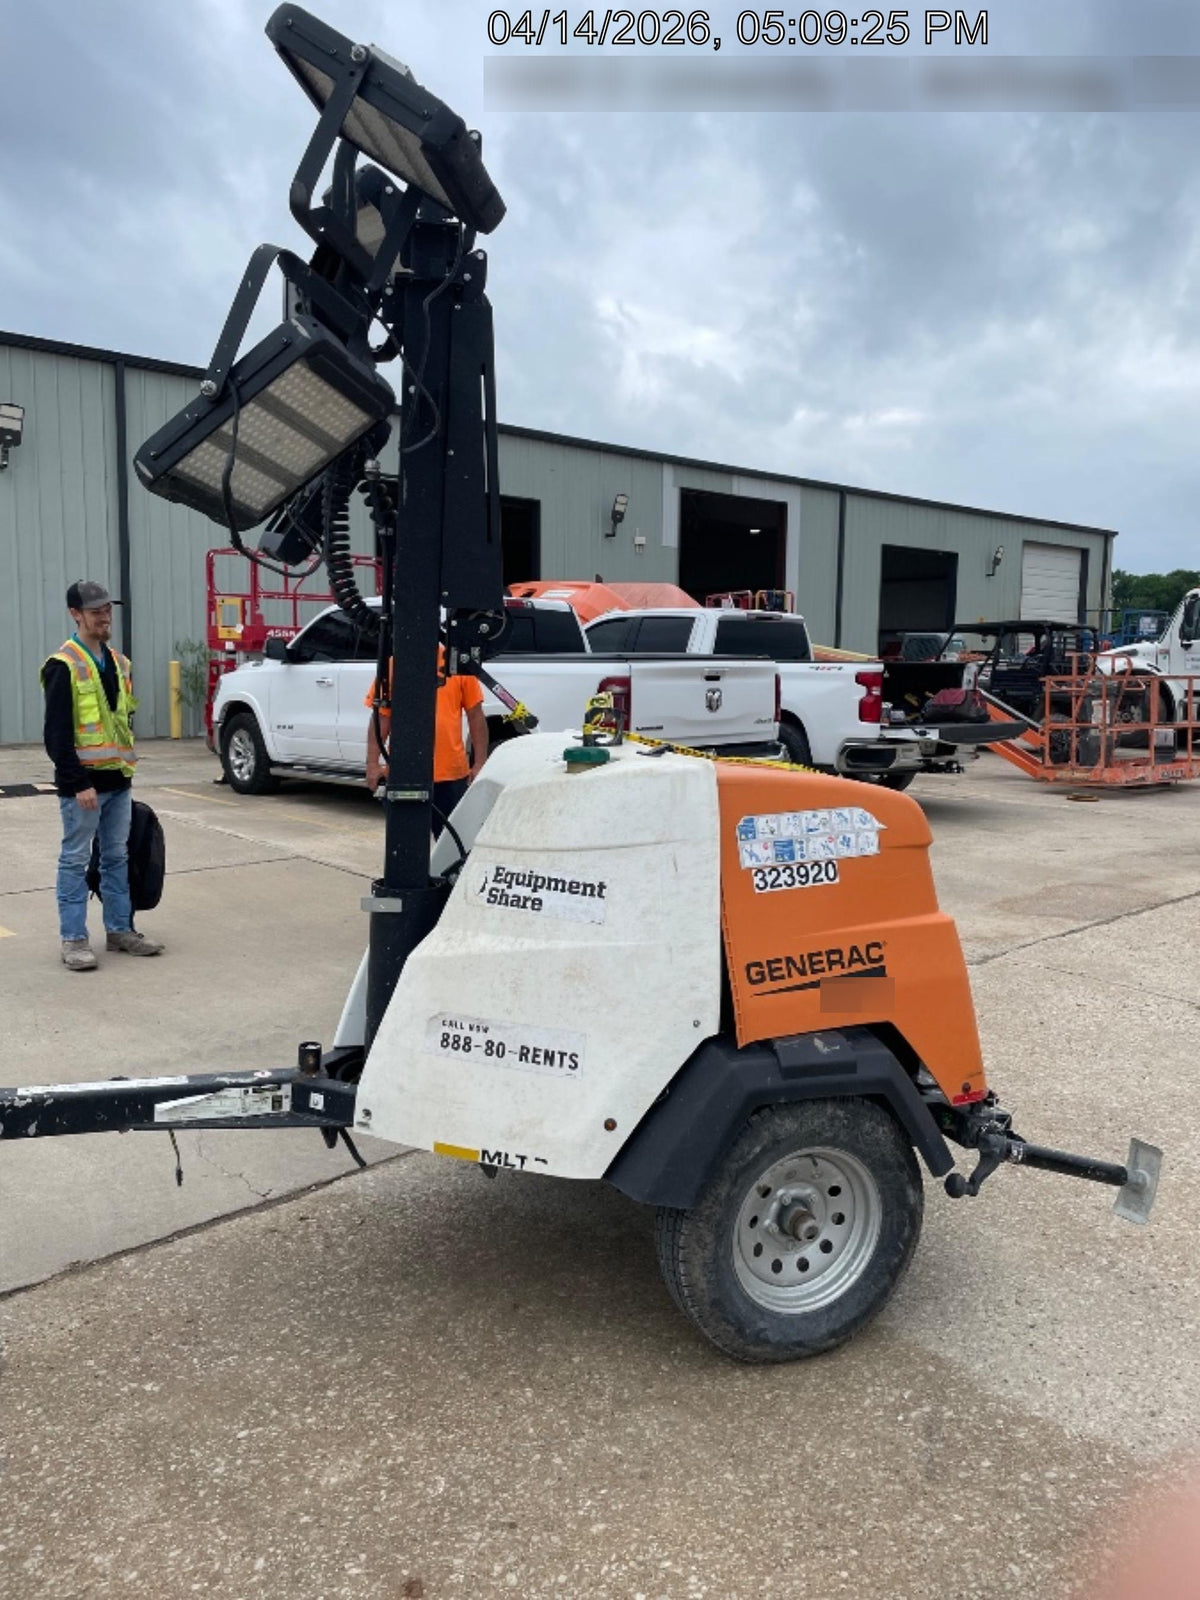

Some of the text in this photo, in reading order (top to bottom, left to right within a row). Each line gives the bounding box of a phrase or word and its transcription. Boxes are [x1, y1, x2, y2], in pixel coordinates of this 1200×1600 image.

[492, 866, 607, 899] Equipment
[753, 861, 838, 891] 323920
[486, 887, 543, 911] Share
[745, 941, 884, 985] GENERAC
[440, 1032, 579, 1070] 888-80-RENTS
